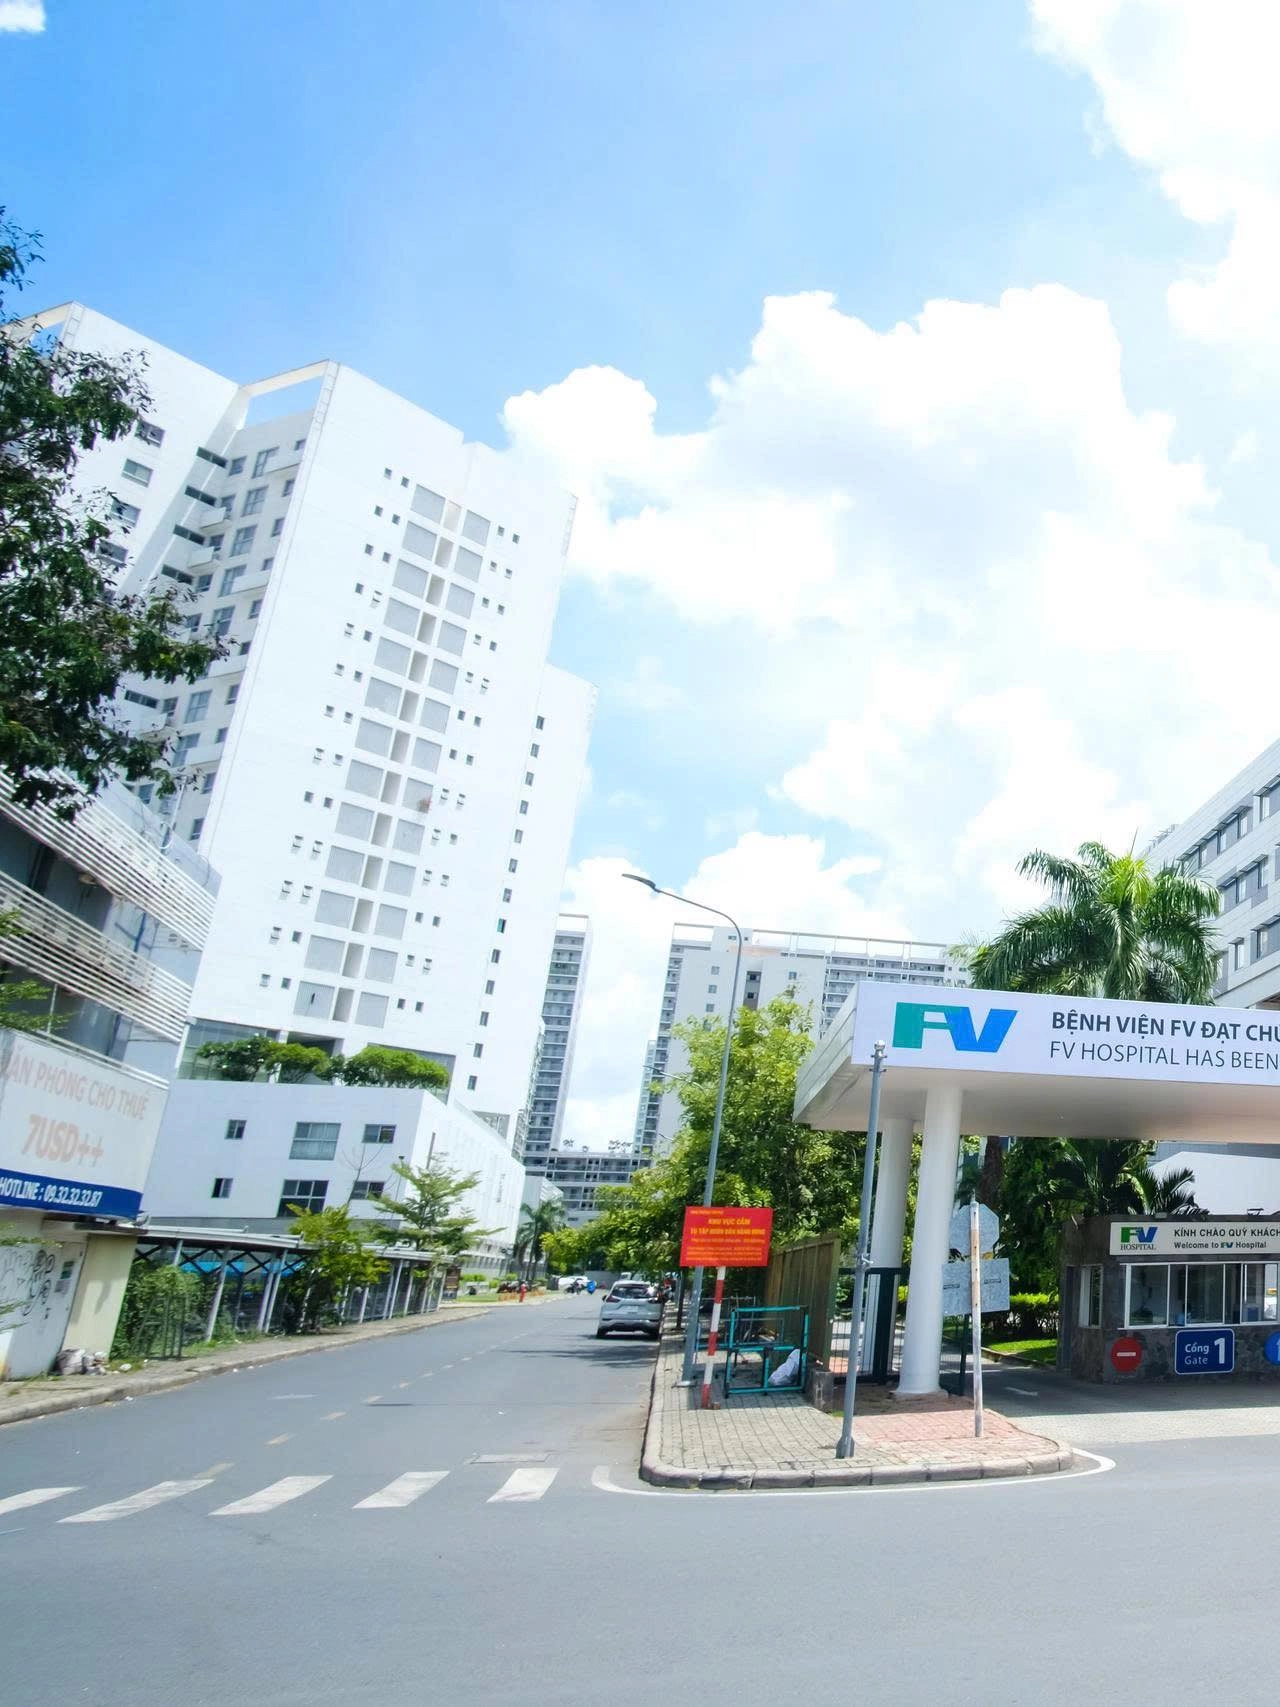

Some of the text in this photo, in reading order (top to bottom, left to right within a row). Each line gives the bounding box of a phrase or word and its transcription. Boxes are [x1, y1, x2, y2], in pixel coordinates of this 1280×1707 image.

[892, 1002, 1018, 1053] FV
[1052, 1009, 1111, 1036] BỆNH
[1116, 1014, 1165, 1039] VIỆN
[1171, 1019, 1196, 1037] FV
[1201, 1022, 1241, 1042] ĐẠT
[1050, 1041, 1076, 1060] FV
[1082, 1043, 1180, 1065] HOSPITAL
[1186, 1048, 1225, 1068] HAS
[1232, 1051, 1279, 1071] BEEN
[3, 1044, 34, 1086] ĂN
[88, 1080, 116, 1112] CHO
[118, 1088, 149, 1120] THUÊ
[1120, 1226, 1158, 1243] FV
[1174, 1226, 1197, 1237] KÍNH
[1200, 1226, 1226, 1237] CHÀO
[1229, 1226, 1247, 1237] QUÝ
[1174, 1241, 1209, 1249] Welcome
[1236, 1241, 1267, 1250] Hospital
[1184, 1356, 1208, 1365] Gate
[1213, 1338, 1226, 1364] 1
